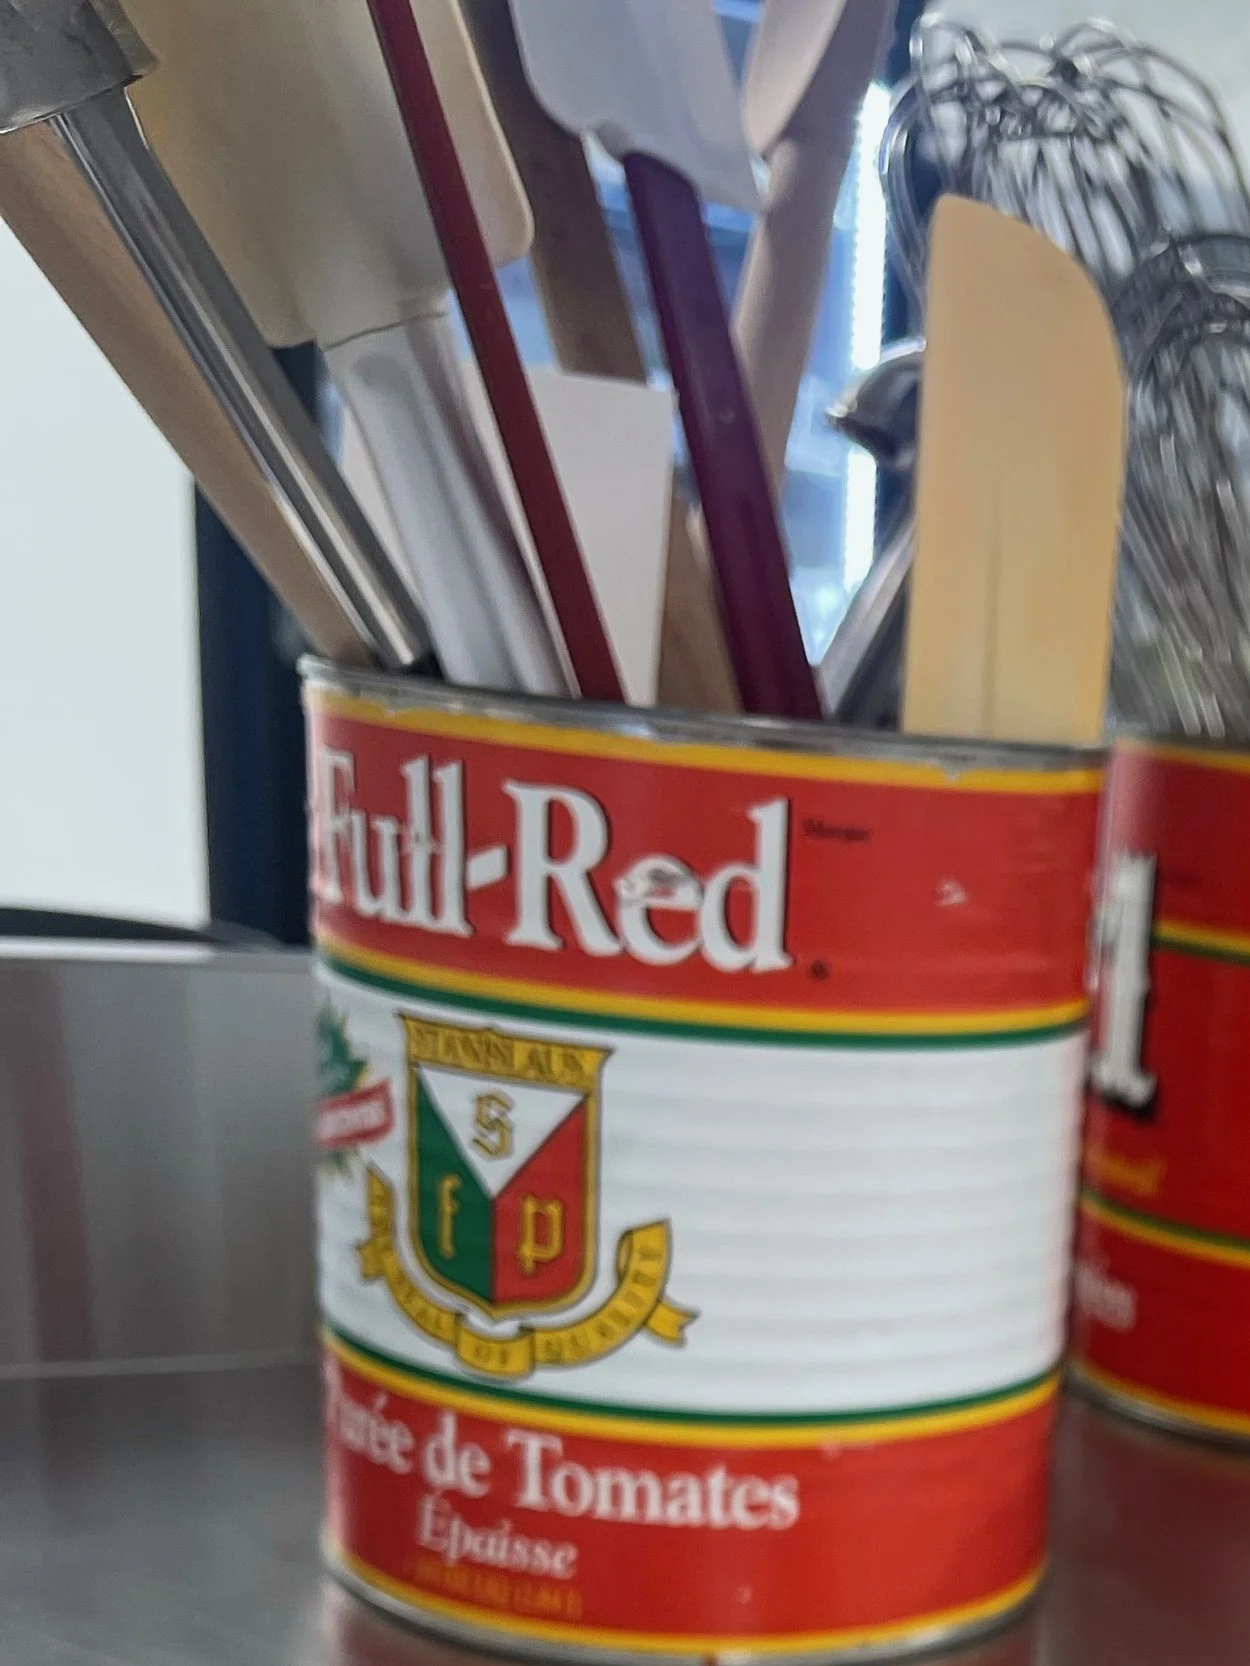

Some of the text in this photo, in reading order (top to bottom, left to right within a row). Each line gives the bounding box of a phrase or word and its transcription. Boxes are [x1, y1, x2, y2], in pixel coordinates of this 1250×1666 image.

[313, 746, 796, 975] Full-Red
[471, 1091, 516, 1160] S
[422, 1408, 492, 1499] de
[503, 1427, 801, 1530] Tomates
